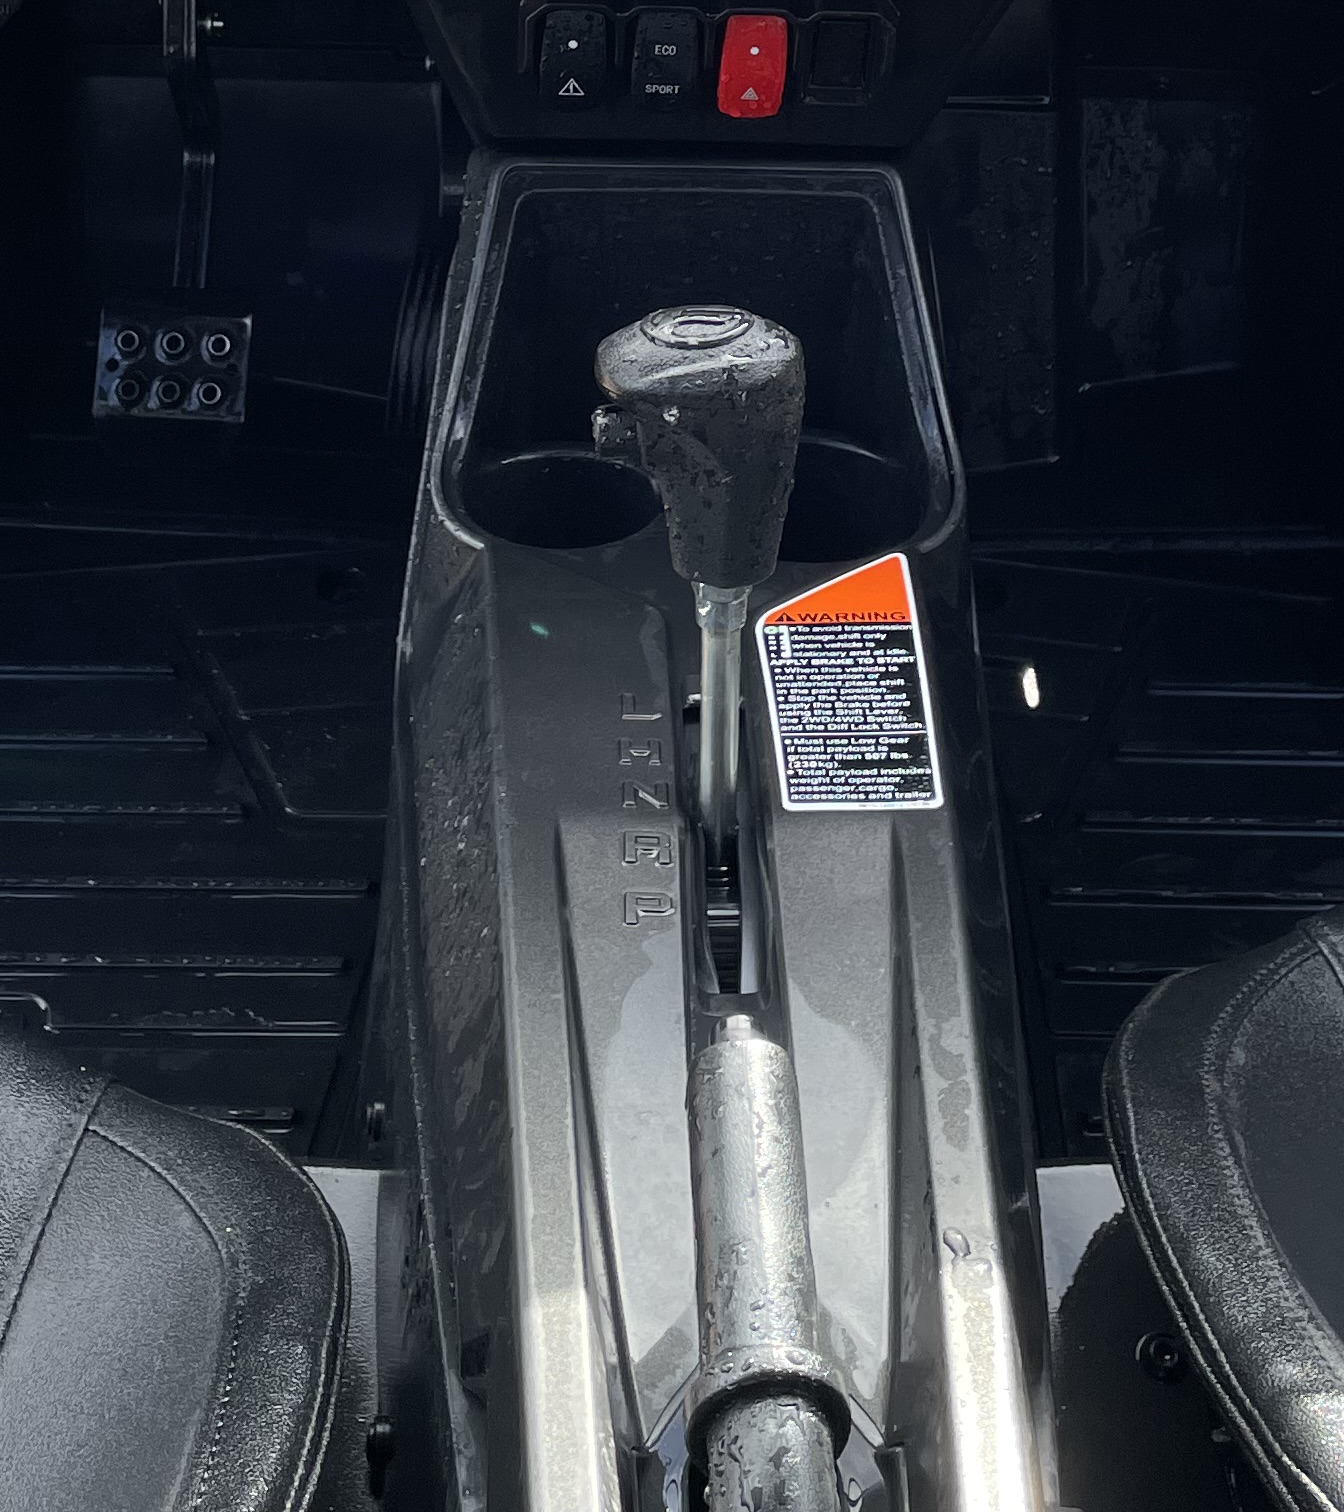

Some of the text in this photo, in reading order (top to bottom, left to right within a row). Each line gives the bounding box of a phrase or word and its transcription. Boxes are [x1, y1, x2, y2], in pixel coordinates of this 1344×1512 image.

[655, 45, 676, 55] ECO
[645, 84, 680, 94] SPORT
[797, 612, 905, 622] WARNING
[621, 693, 662, 720] L
[619, 738, 661, 765] H
[622, 781, 669, 808] N
[622, 830, 674, 867] R
[622, 891, 675, 927] P
